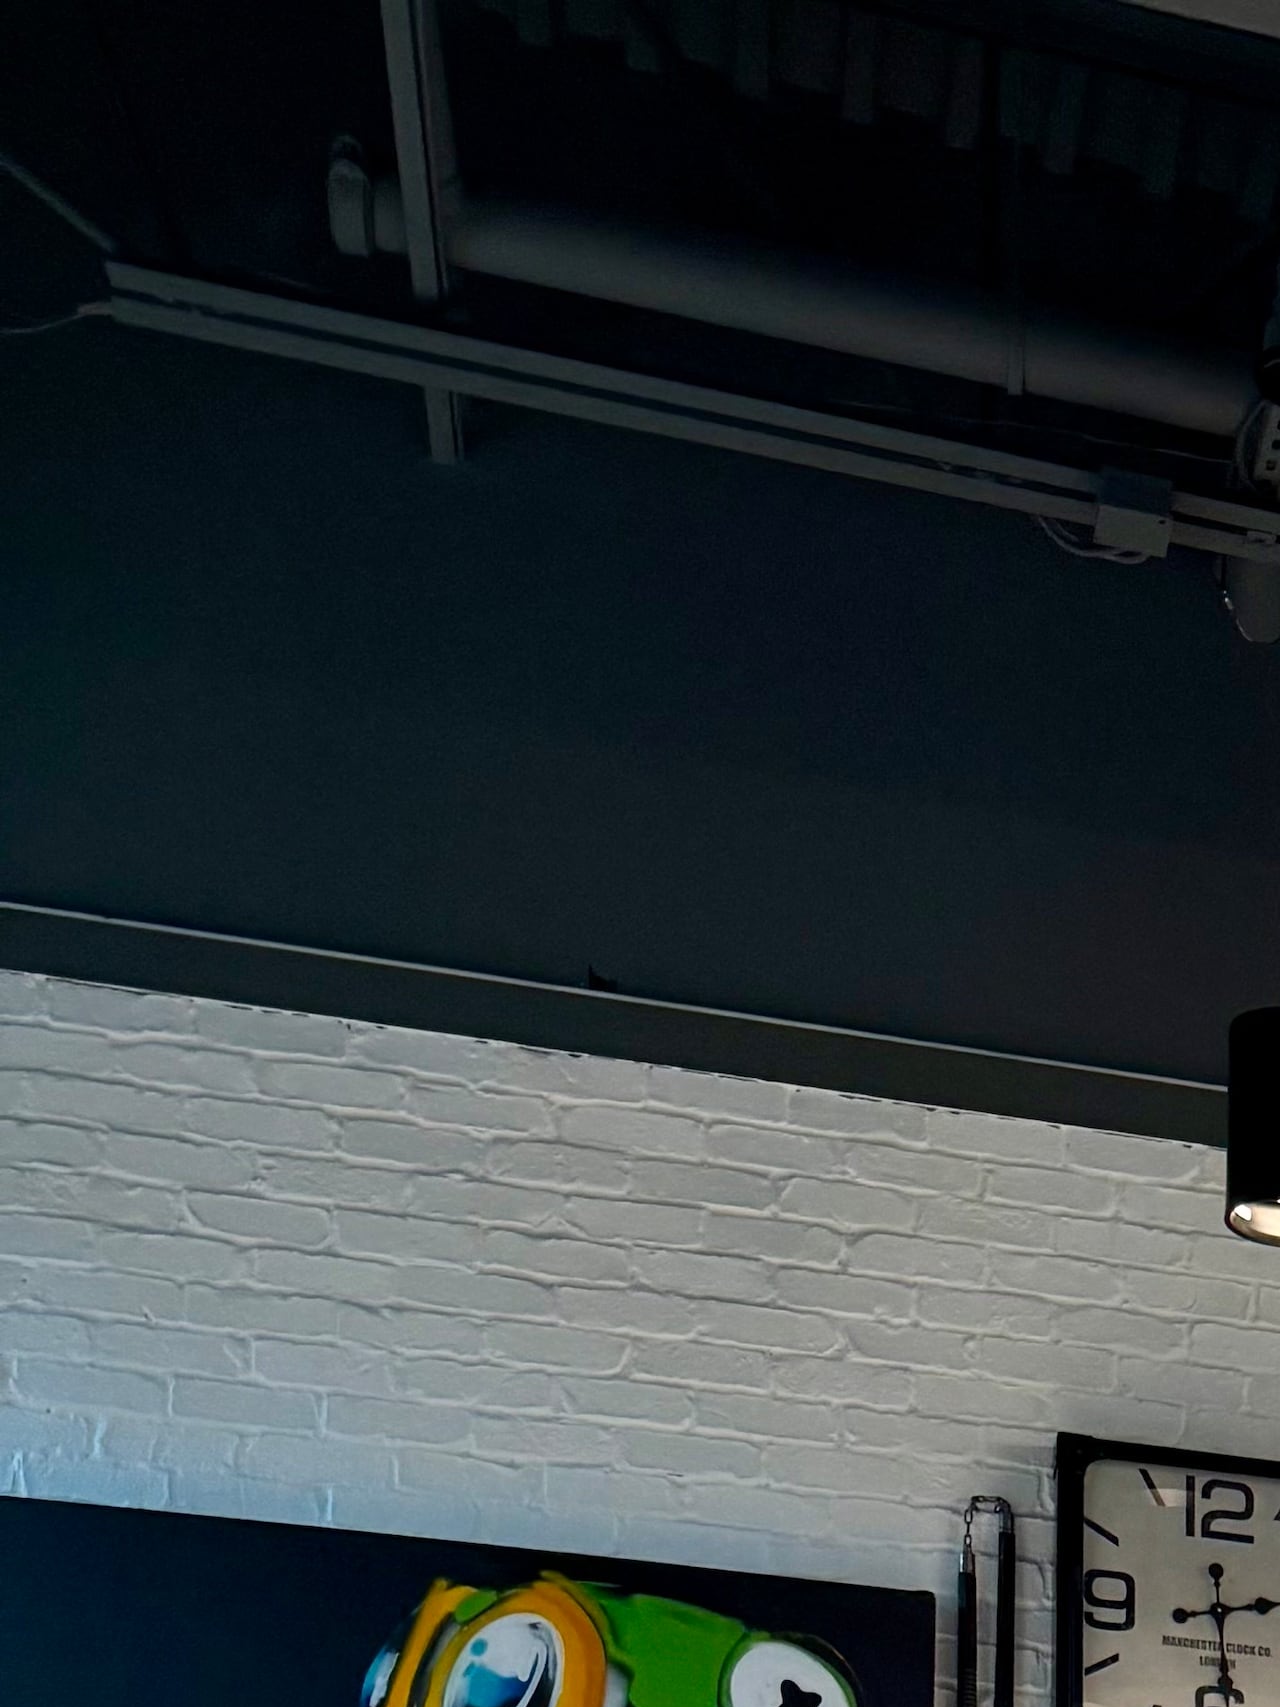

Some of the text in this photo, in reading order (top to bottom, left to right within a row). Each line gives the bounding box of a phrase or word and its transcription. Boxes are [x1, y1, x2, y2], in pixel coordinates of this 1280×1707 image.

[1185, 1475, 1254, 1544] 12
[1084, 1569, 1135, 1631] 9
[1199, 1655, 1236, 1670] LONDN
[1226, 1642, 1256, 1656] CLOCK
